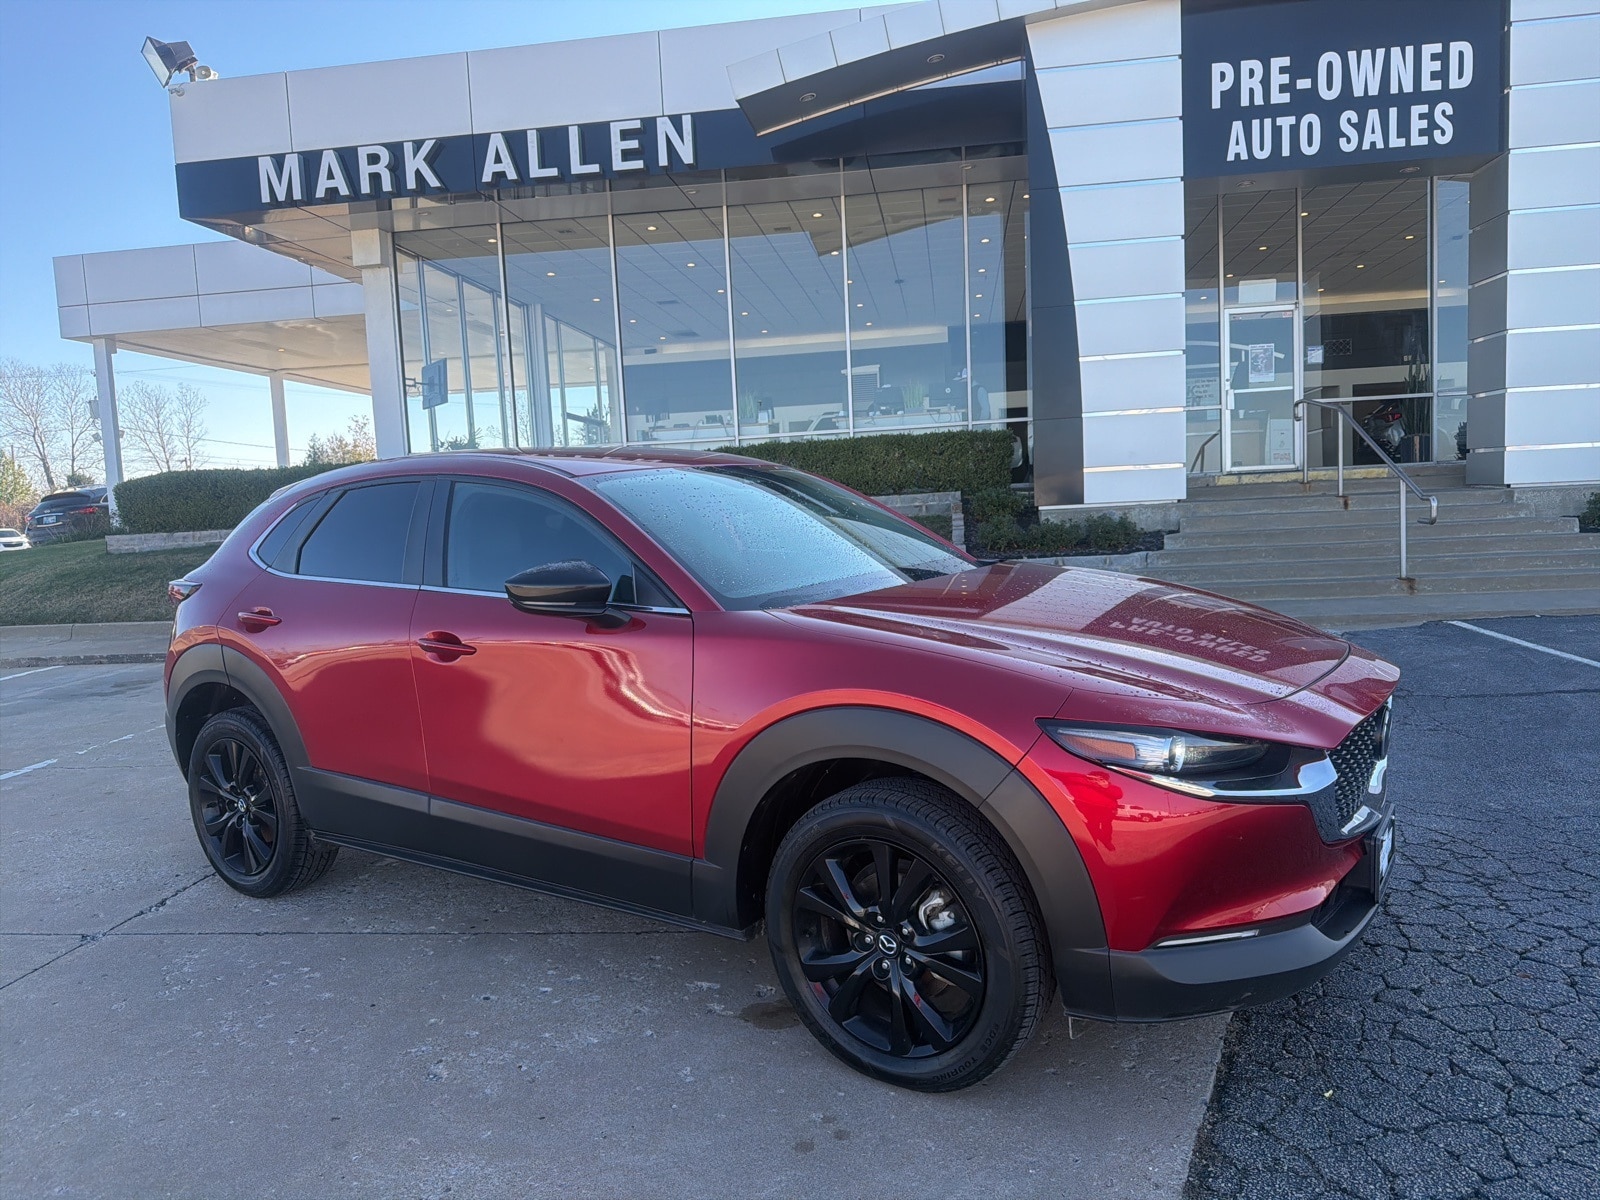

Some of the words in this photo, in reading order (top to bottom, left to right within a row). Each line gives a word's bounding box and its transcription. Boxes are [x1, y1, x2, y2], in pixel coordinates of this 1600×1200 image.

[1211, 41, 1474, 109] PRE-OWNED
[258, 140, 446, 203] MARK
[482, 115, 696, 184] ALLEN
[1226, 113, 1322, 162] AUTO
[1338, 102, 1454, 153] SALES
